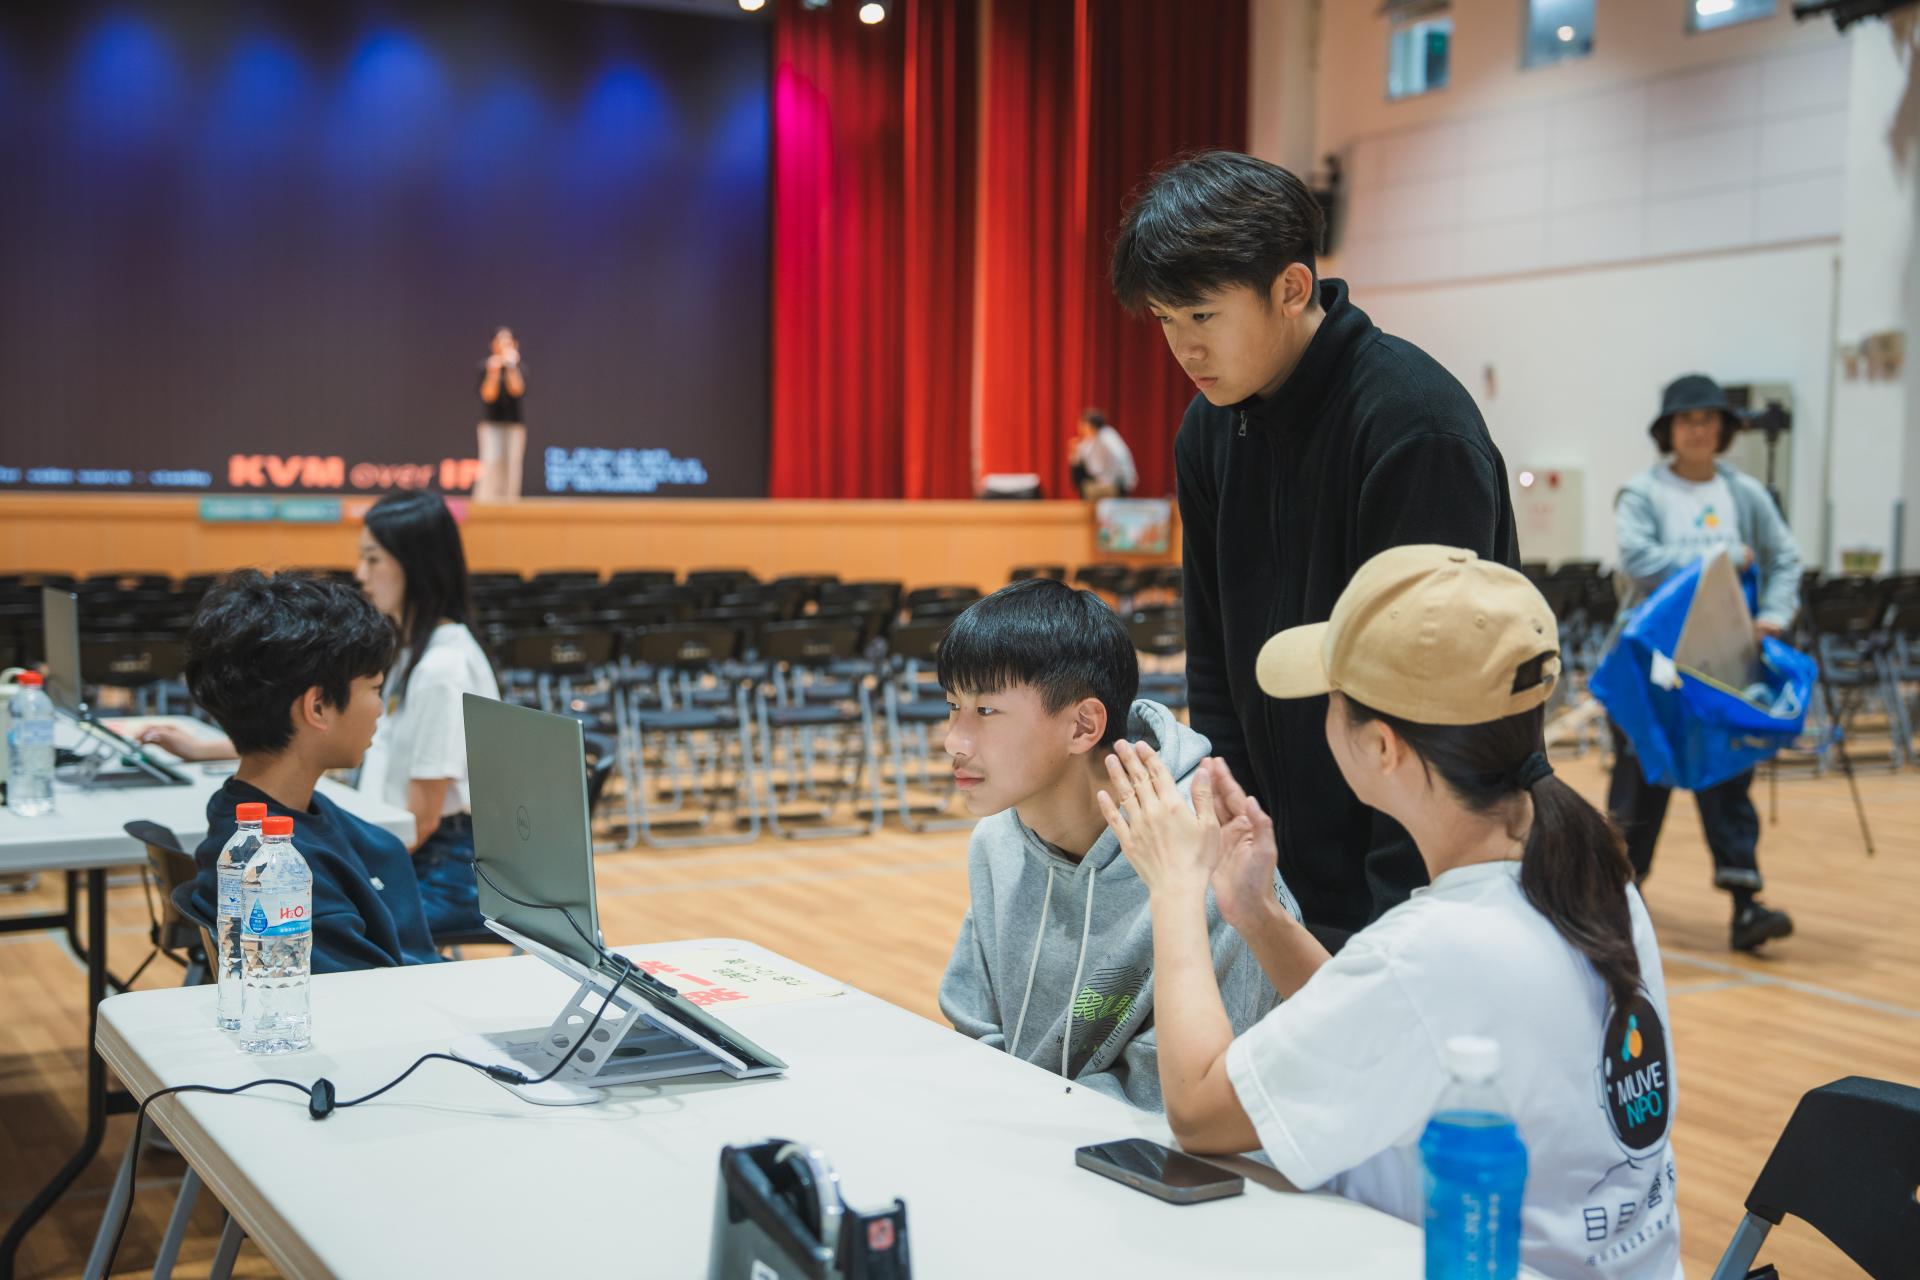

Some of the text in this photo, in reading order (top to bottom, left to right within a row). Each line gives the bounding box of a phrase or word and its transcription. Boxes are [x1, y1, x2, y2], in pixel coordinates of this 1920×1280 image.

[229, 455, 345, 488] KVM
[350, 462, 433, 489] over
[440, 458, 484, 489] IP
[1617, 1061, 1664, 1106] MUVE
[1626, 1090, 1662, 1128] NPO
